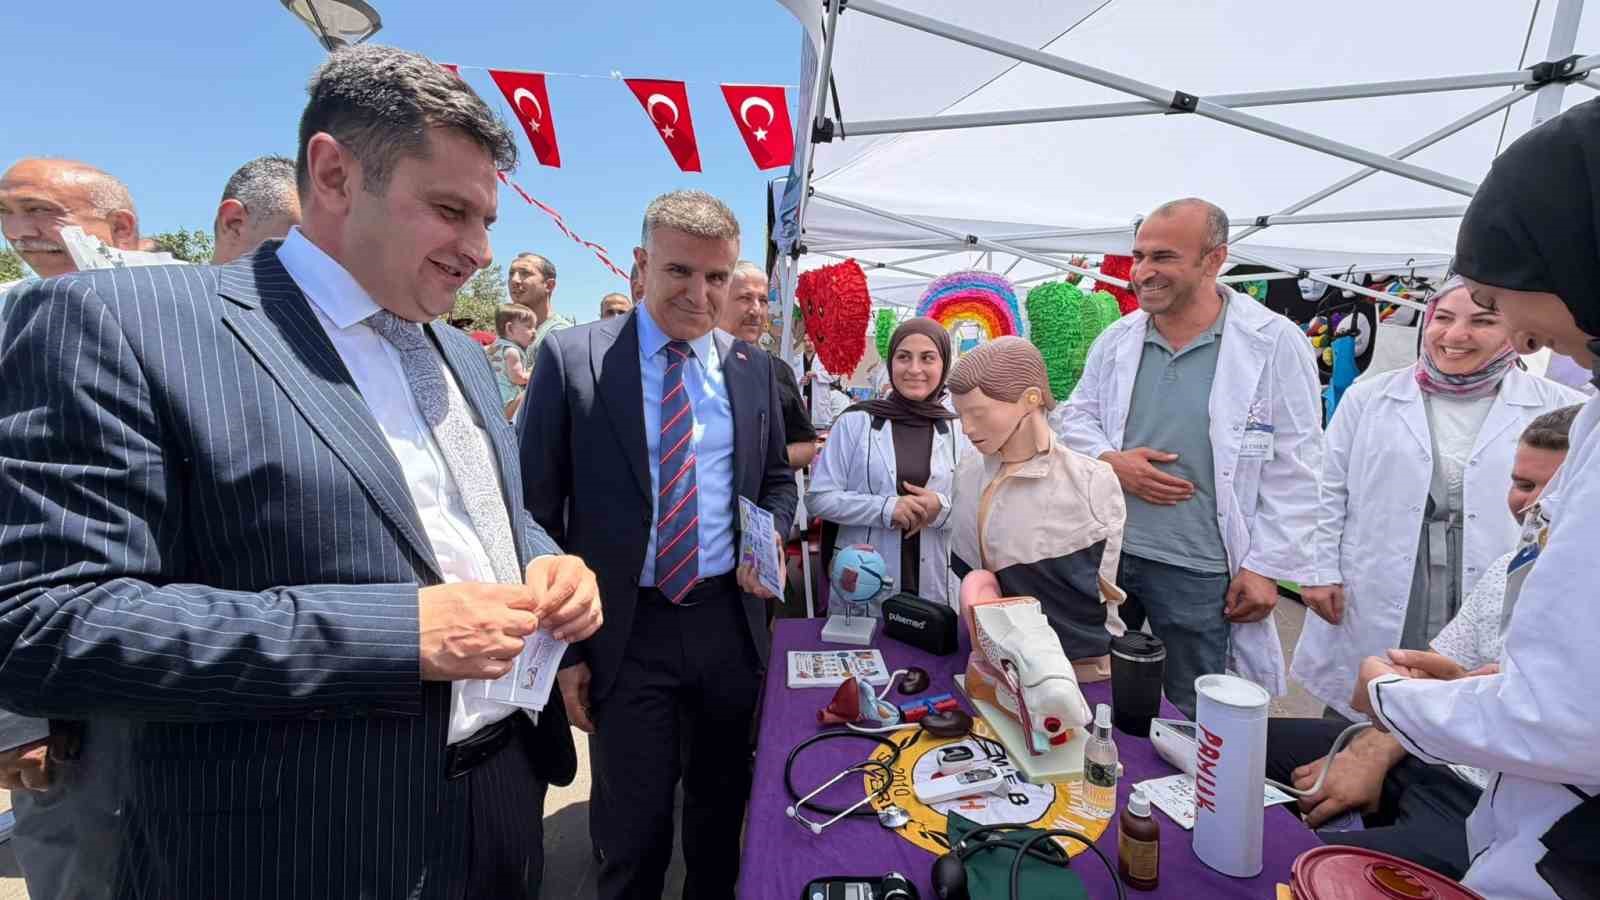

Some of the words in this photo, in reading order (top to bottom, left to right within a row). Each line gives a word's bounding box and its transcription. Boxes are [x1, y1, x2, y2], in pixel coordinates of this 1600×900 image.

[888, 612, 927, 630] pulsemed
[893, 767, 911, 797] 2010
[1197, 722, 1223, 813] PAMUK
